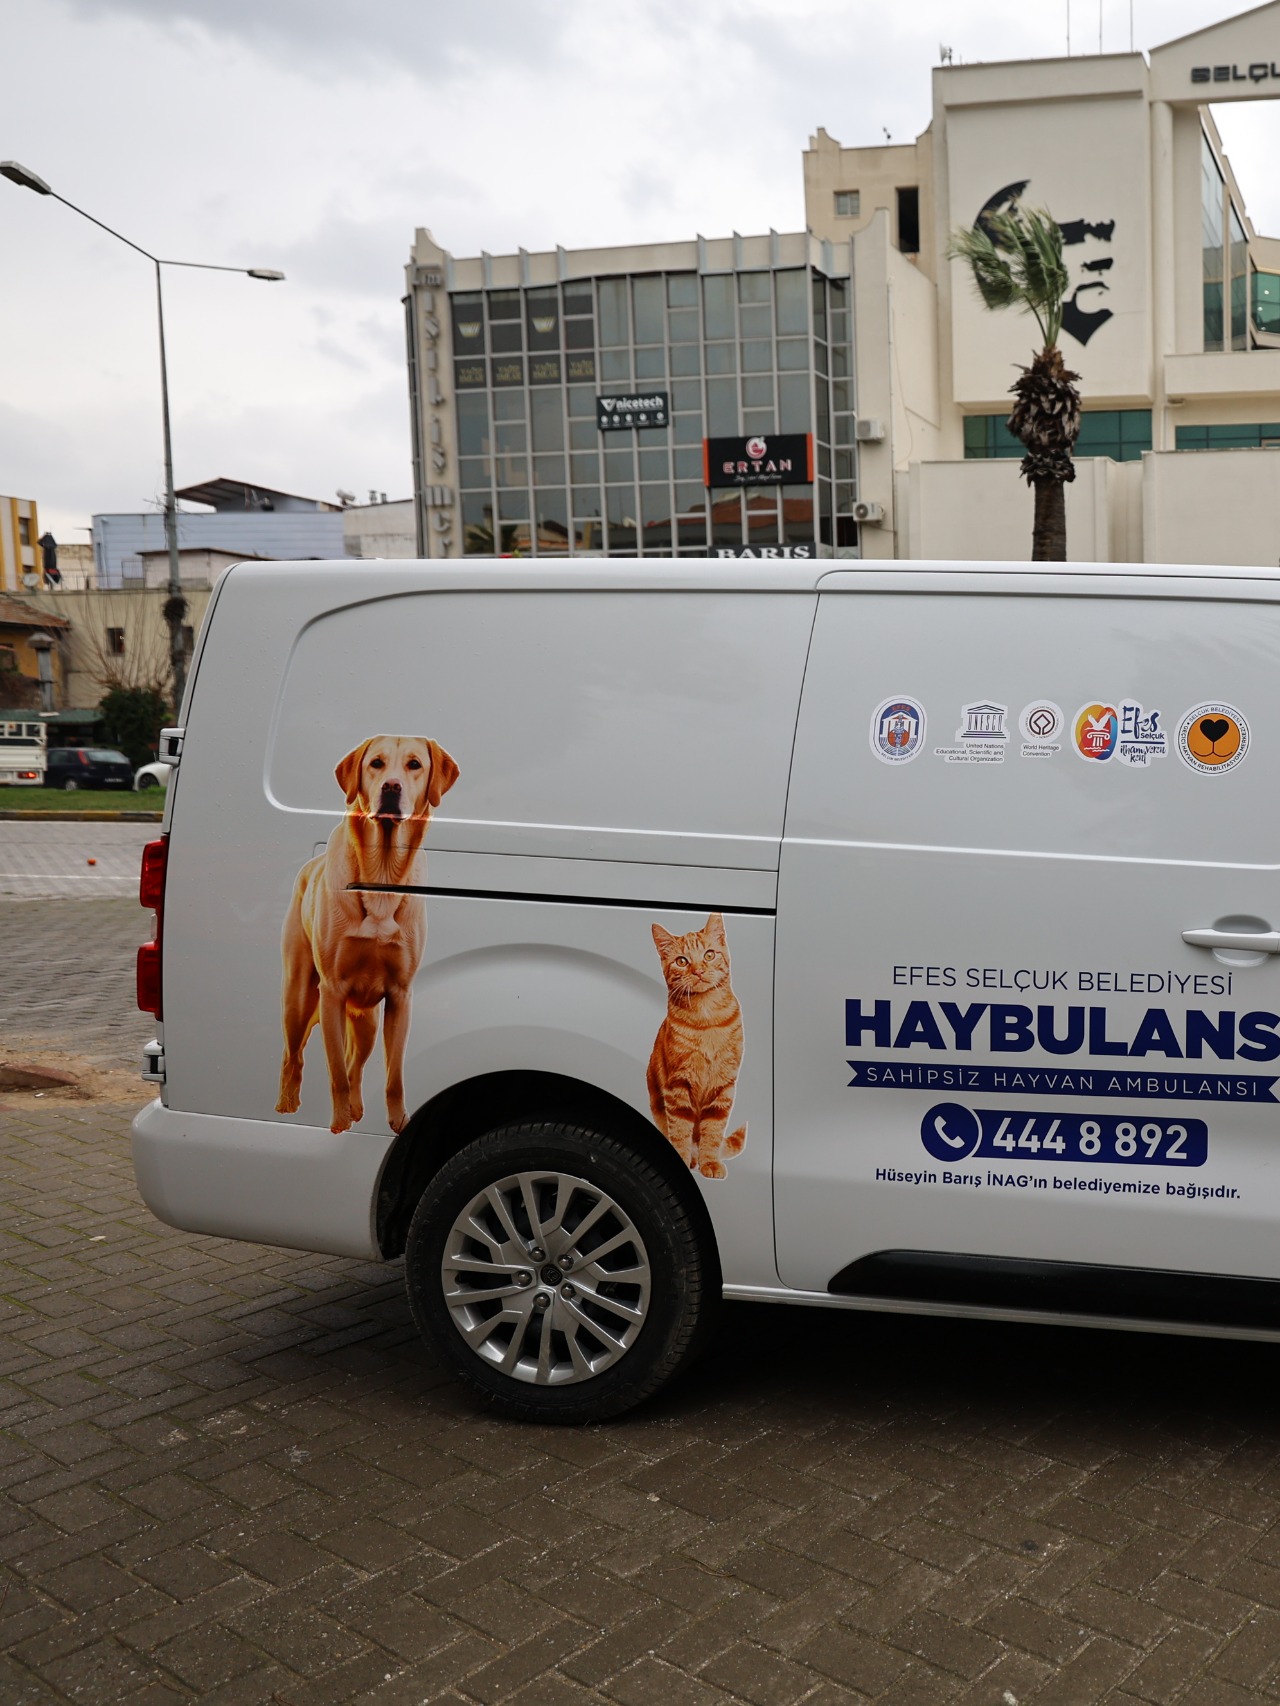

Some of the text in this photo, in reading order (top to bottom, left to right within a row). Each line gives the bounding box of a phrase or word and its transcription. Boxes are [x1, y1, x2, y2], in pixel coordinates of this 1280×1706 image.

[722, 459, 793, 474] ERTAN
[967, 714, 1003, 731] UNESCO
[1121, 705, 1159, 739] Efes
[893, 966, 1233, 996] EFES SELÇUK BELEDİYESİ
[867, 1067, 1257, 1096] SAHİPSİZ HAYVAN AMBULANSI
[992, 1117, 1188, 1160] 444 8 892
[875, 1168, 937, 1185] Hüseyin
[942, 1171, 982, 1188] Barış
[1053, 1176, 1161, 1195] belediyemize
[1166, 1182, 1241, 1200] bağışıdır.
